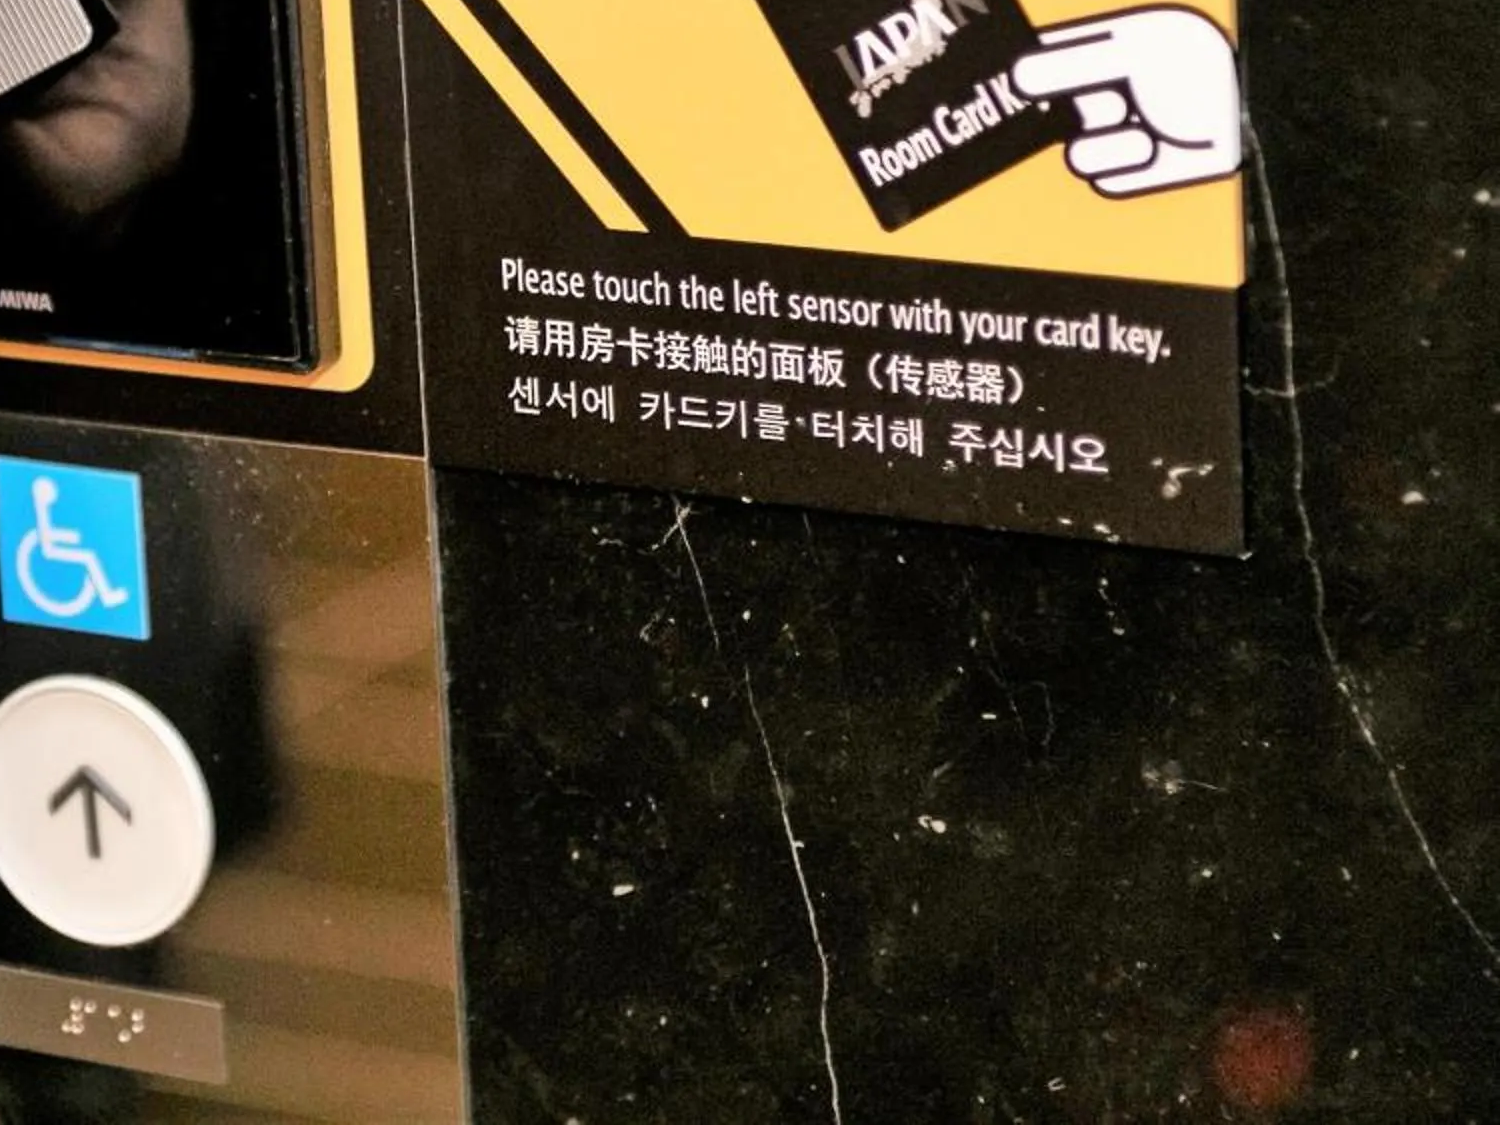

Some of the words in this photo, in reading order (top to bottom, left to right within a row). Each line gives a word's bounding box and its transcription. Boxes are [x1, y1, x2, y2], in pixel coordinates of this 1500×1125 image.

[858, 125, 943, 188] Room
[933, 82, 1003, 146] Card
[500, 255, 586, 299] Please
[591, 269, 672, 308] touch
[677, 273, 725, 313] the
[732, 277, 780, 318] left
[786, 287, 884, 329] sensor
[887, 297, 953, 336] with
[958, 305, 1028, 347] your
[1033, 312, 1101, 350] card
[1107, 315, 1173, 365] key.
[502, 313, 1026, 406] 请用房卡接触的面板（传感器）
[505, 374, 616, 426] 센서에
[637, 390, 790, 442] 카드키를
[810, 408, 925, 458] 터치해
[946, 420, 1110, 476] 주십시오
